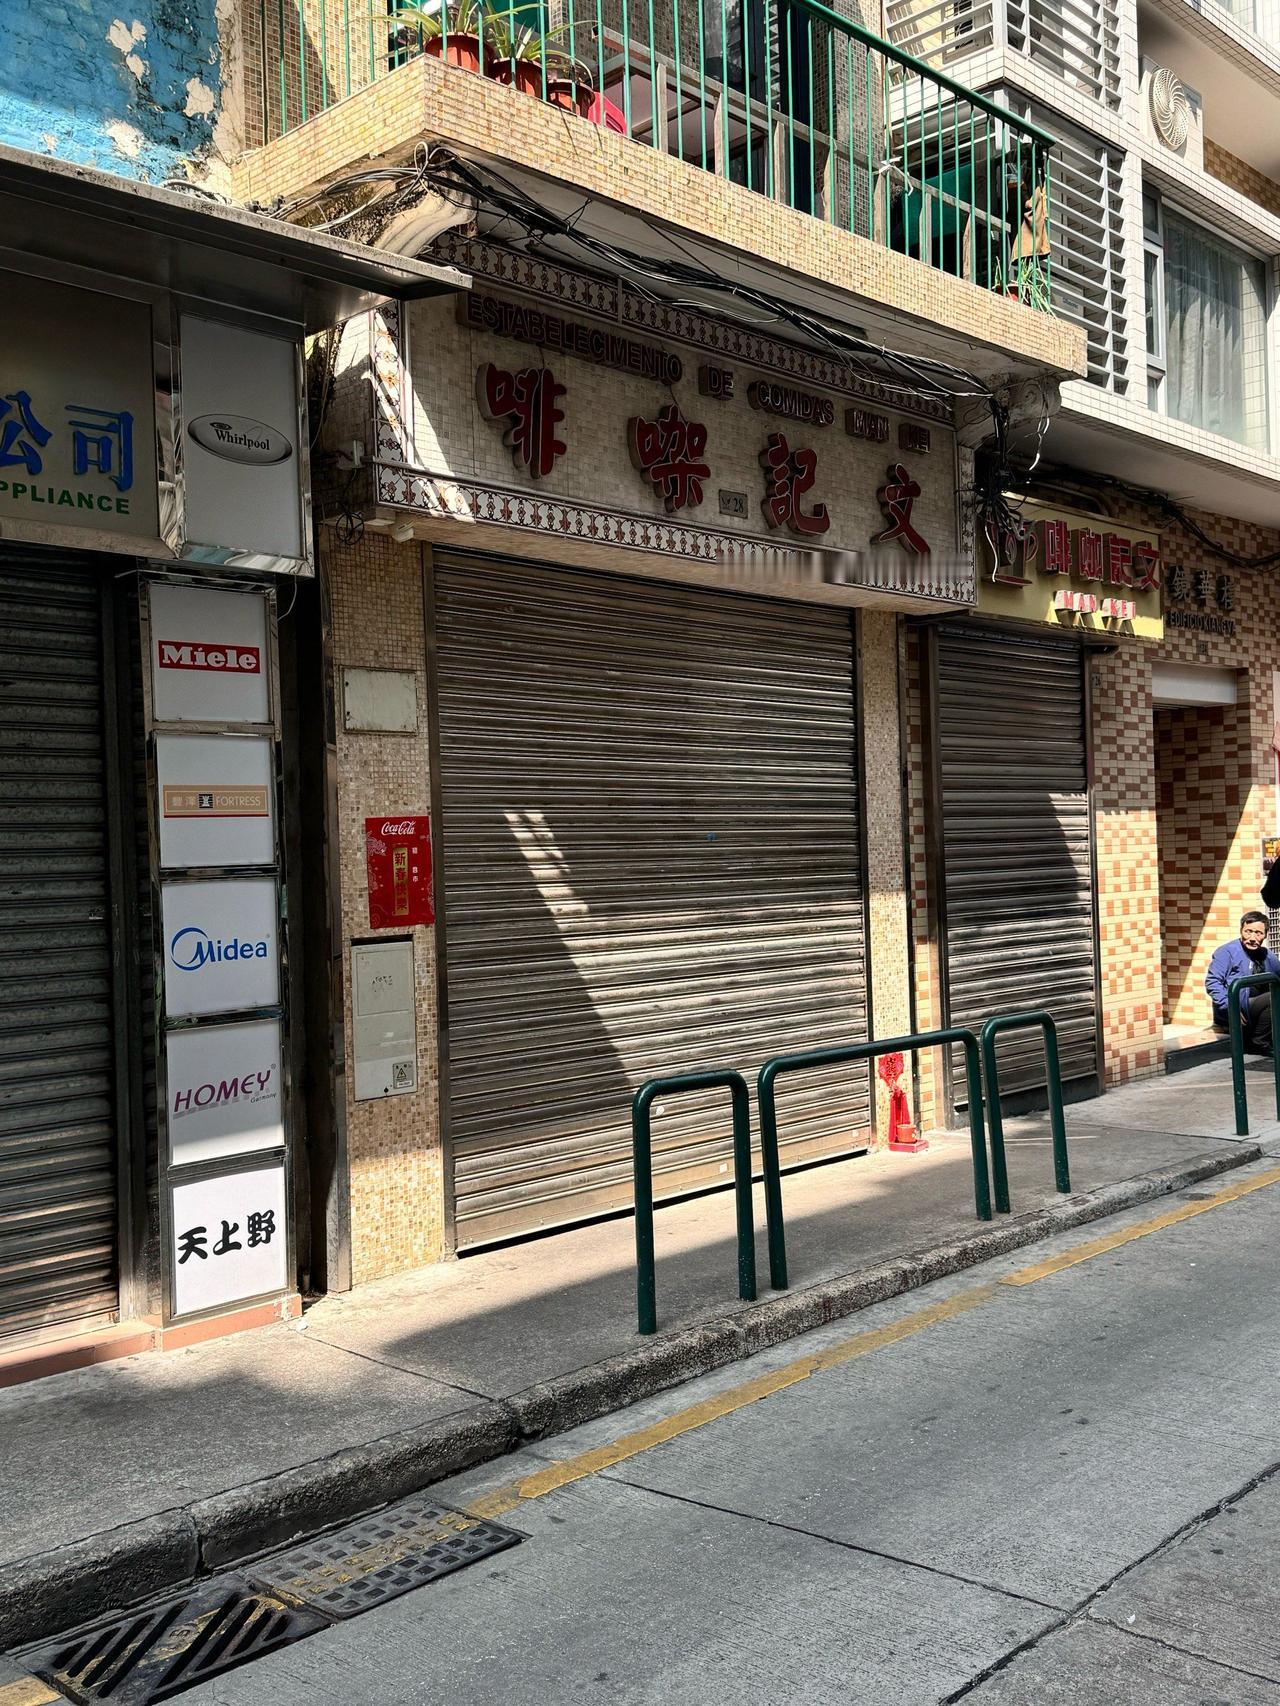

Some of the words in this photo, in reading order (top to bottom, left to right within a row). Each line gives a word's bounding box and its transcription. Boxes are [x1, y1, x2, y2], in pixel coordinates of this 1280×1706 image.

[466, 291, 683, 383] ESTABELECIMENTO
[706, 364, 734, 398] DE
[756, 379, 835, 427] COMIDAS
[852, 408, 890, 442] MAN
[905, 423, 931, 454] KEI
[0, 390, 134, 492] 公司
[215, 427, 270, 451] Whirlpool
[734, 497, 744, 513] 28
[1062, 589, 1097, 613] MAN
[1108, 598, 1136, 620] KEI
[161, 643, 257, 671] Miele
[215, 796, 261, 807] FORTRESS
[185, 937, 268, 966] Midea
[174, 1070, 271, 1113] HOMEY
[176, 1208, 276, 1267] 天上野
